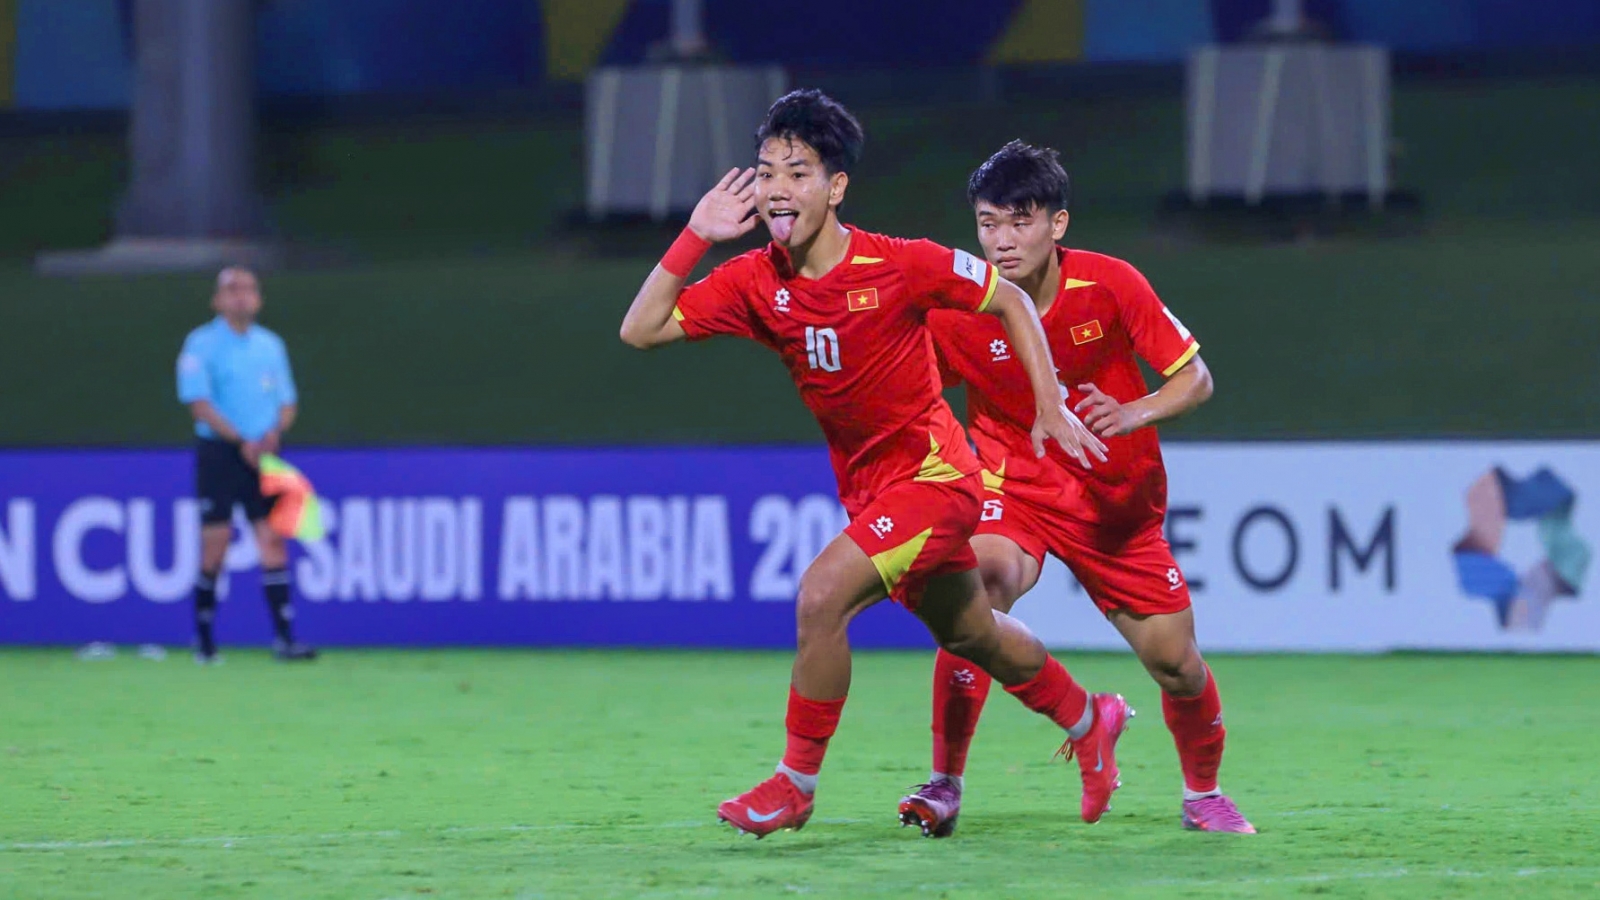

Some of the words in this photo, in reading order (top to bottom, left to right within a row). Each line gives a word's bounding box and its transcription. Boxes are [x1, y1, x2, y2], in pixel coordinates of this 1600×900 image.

[805, 326, 842, 372] 10
[297, 496, 483, 602] SAUDI
[498, 496, 733, 601] ARABIA
[750, 494, 851, 602] 20
[1069, 505, 1397, 592] EOM
